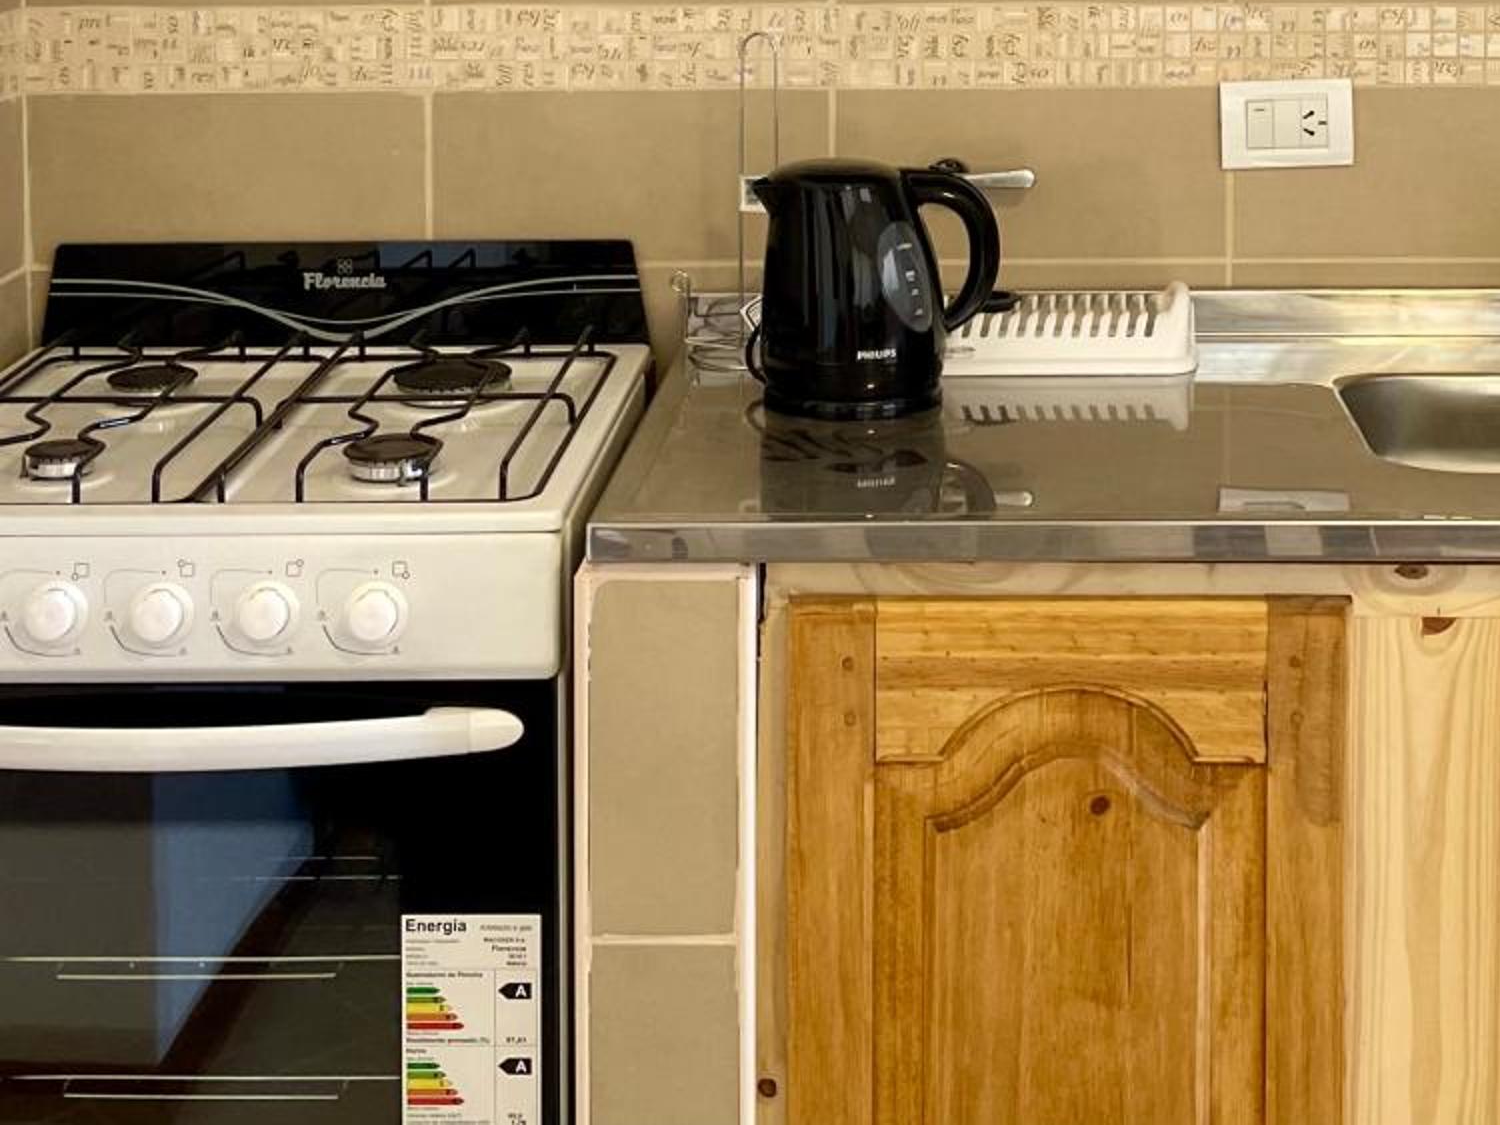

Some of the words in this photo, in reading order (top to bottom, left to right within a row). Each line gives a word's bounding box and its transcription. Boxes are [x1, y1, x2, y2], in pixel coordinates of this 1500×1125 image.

[303, 272, 387, 291] Florencia
[515, 985, 527, 997] A
[515, 1060, 527, 1072] A
